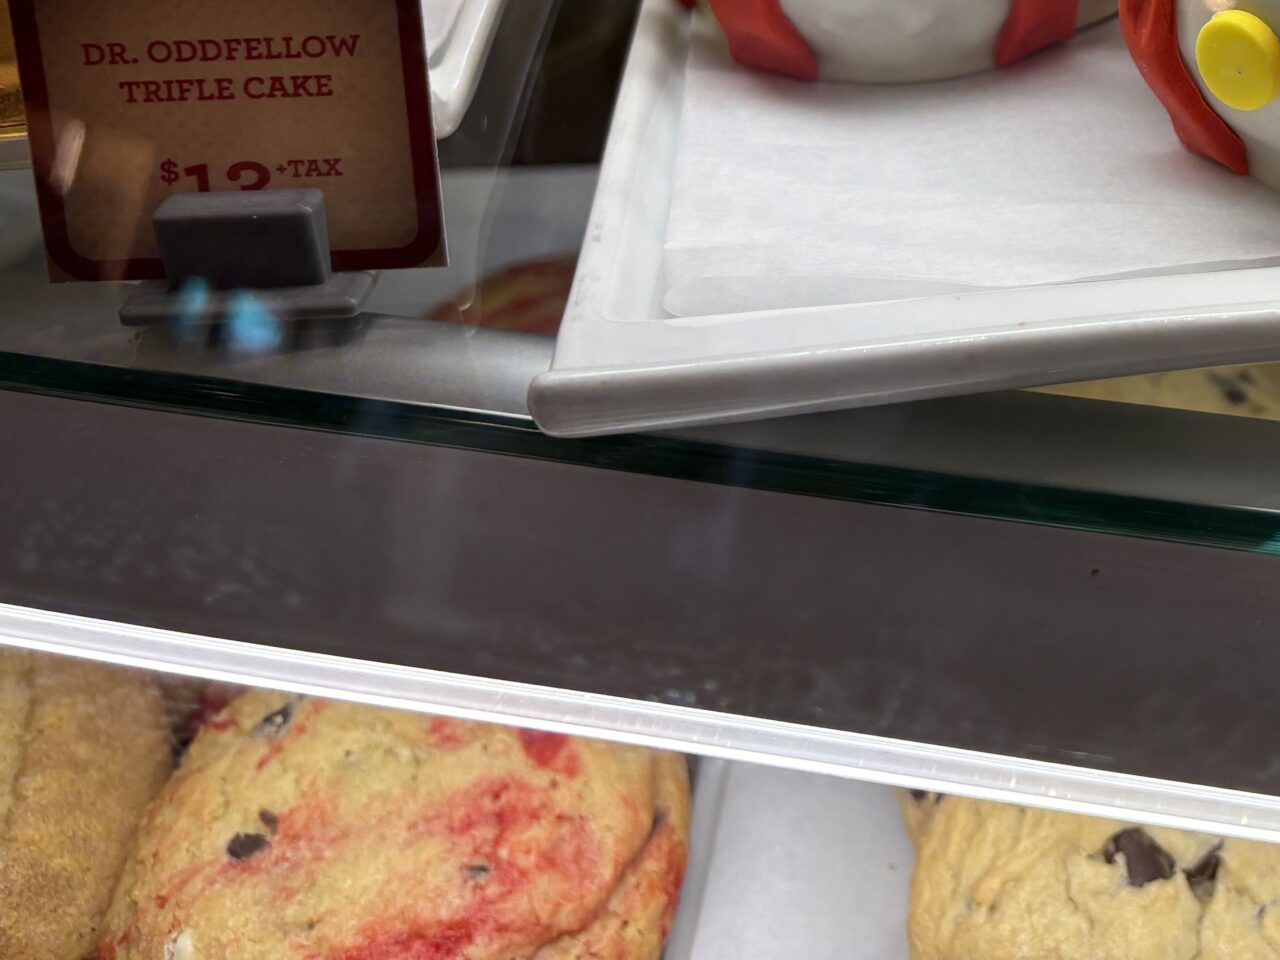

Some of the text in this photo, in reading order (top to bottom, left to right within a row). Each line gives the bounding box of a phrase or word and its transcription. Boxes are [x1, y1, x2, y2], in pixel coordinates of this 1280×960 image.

[81, 34, 360, 66] DR. ODDFELLOW
[119, 74, 334, 103] TRIFLE CAKE
